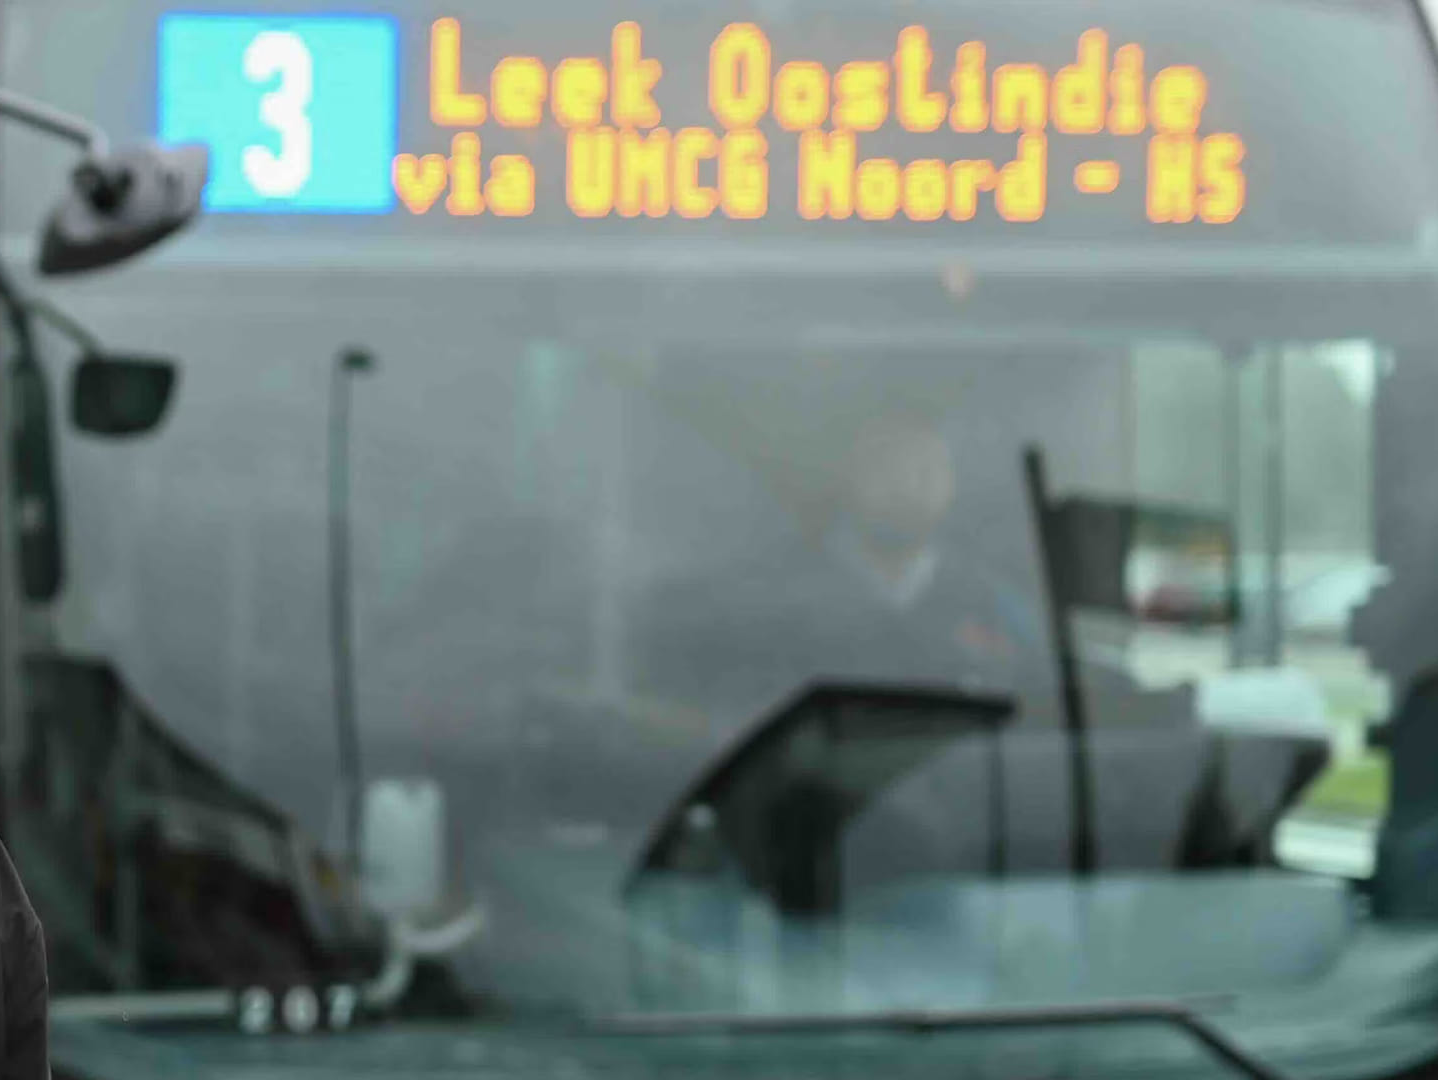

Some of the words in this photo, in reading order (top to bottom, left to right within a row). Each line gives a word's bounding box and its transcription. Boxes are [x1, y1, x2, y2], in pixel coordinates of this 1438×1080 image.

[243, 31, 313, 199] 3
[430, 17, 662, 128] Leek
[708, 22, 1208, 135] Oostindie
[393, 132, 535, 216] via
[566, 127, 769, 219] UMCG
[797, 128, 1048, 222] Noord
